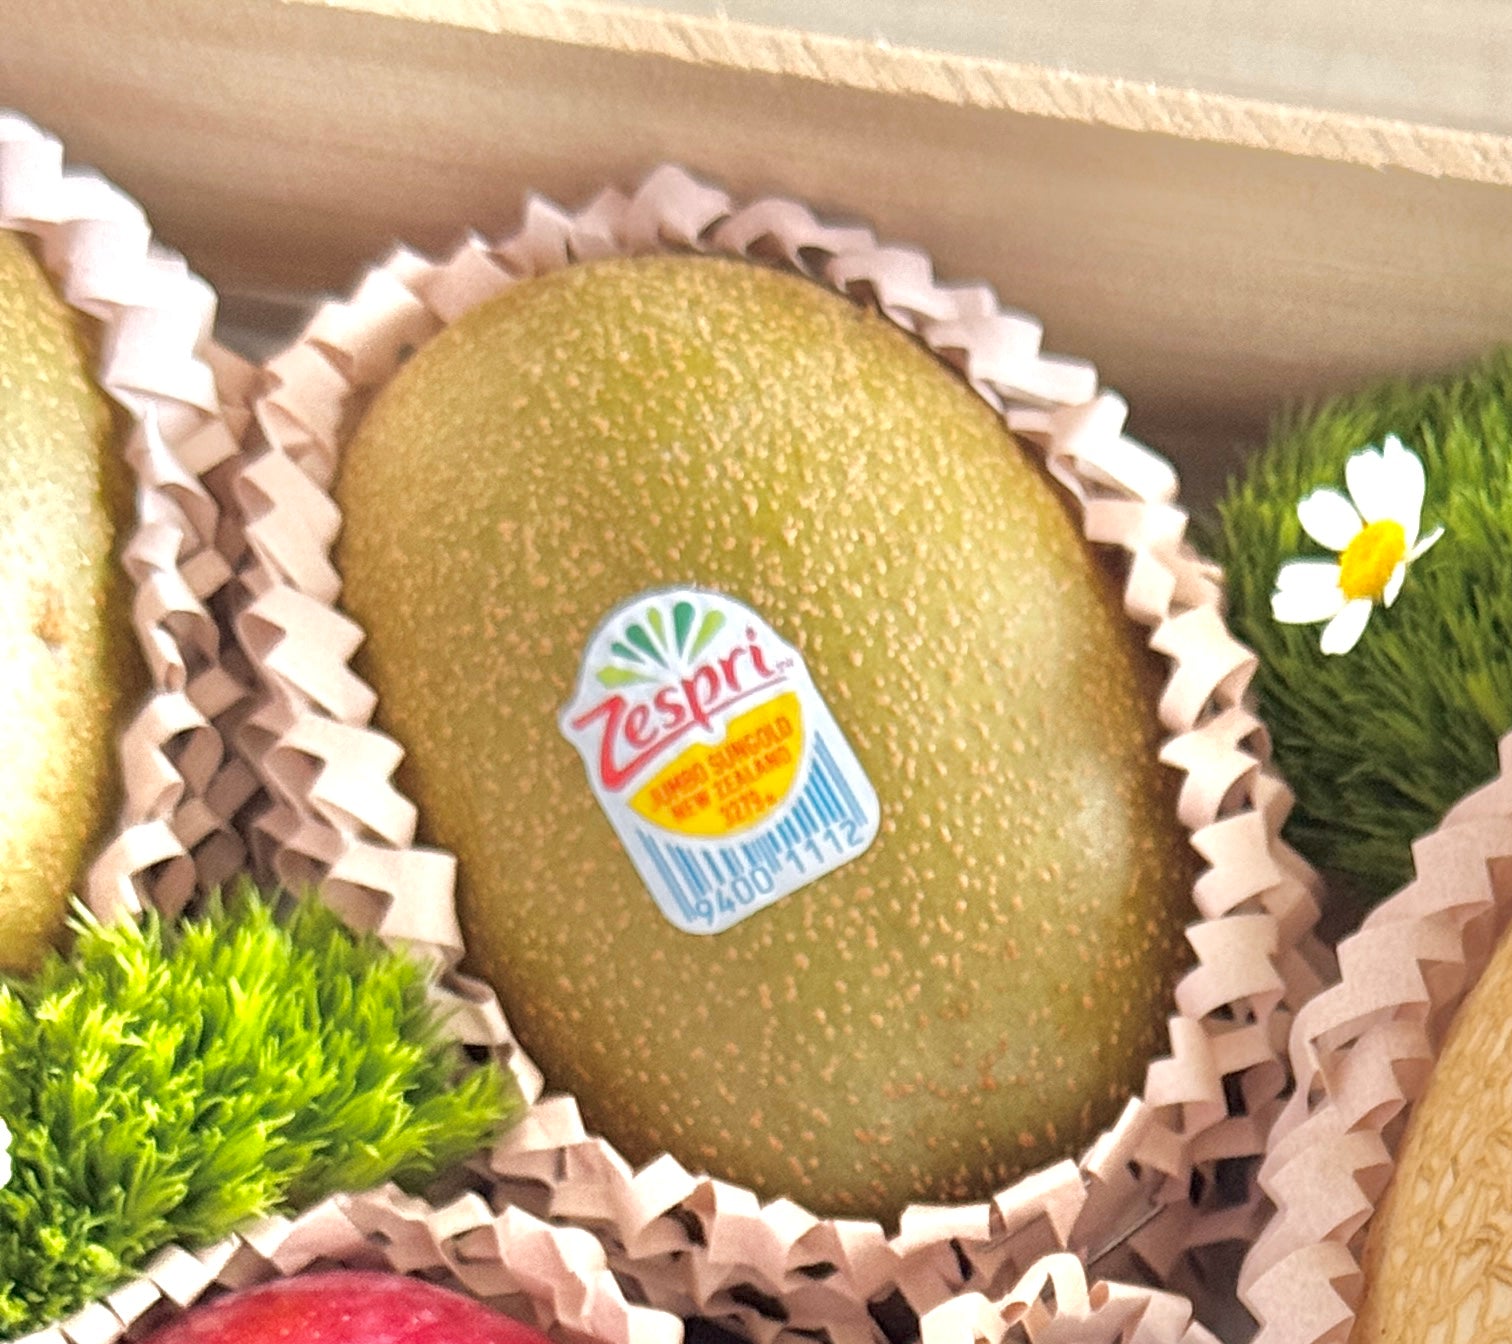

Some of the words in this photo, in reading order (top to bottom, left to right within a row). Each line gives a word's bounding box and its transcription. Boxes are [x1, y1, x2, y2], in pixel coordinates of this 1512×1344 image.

[571, 626, 780, 792] Zespri
[708, 716, 794, 774] SUNGOLD
[714, 746, 792, 799] ZEALAND
[695, 867, 775, 925] 9400
[786, 819, 865, 874] 1112
